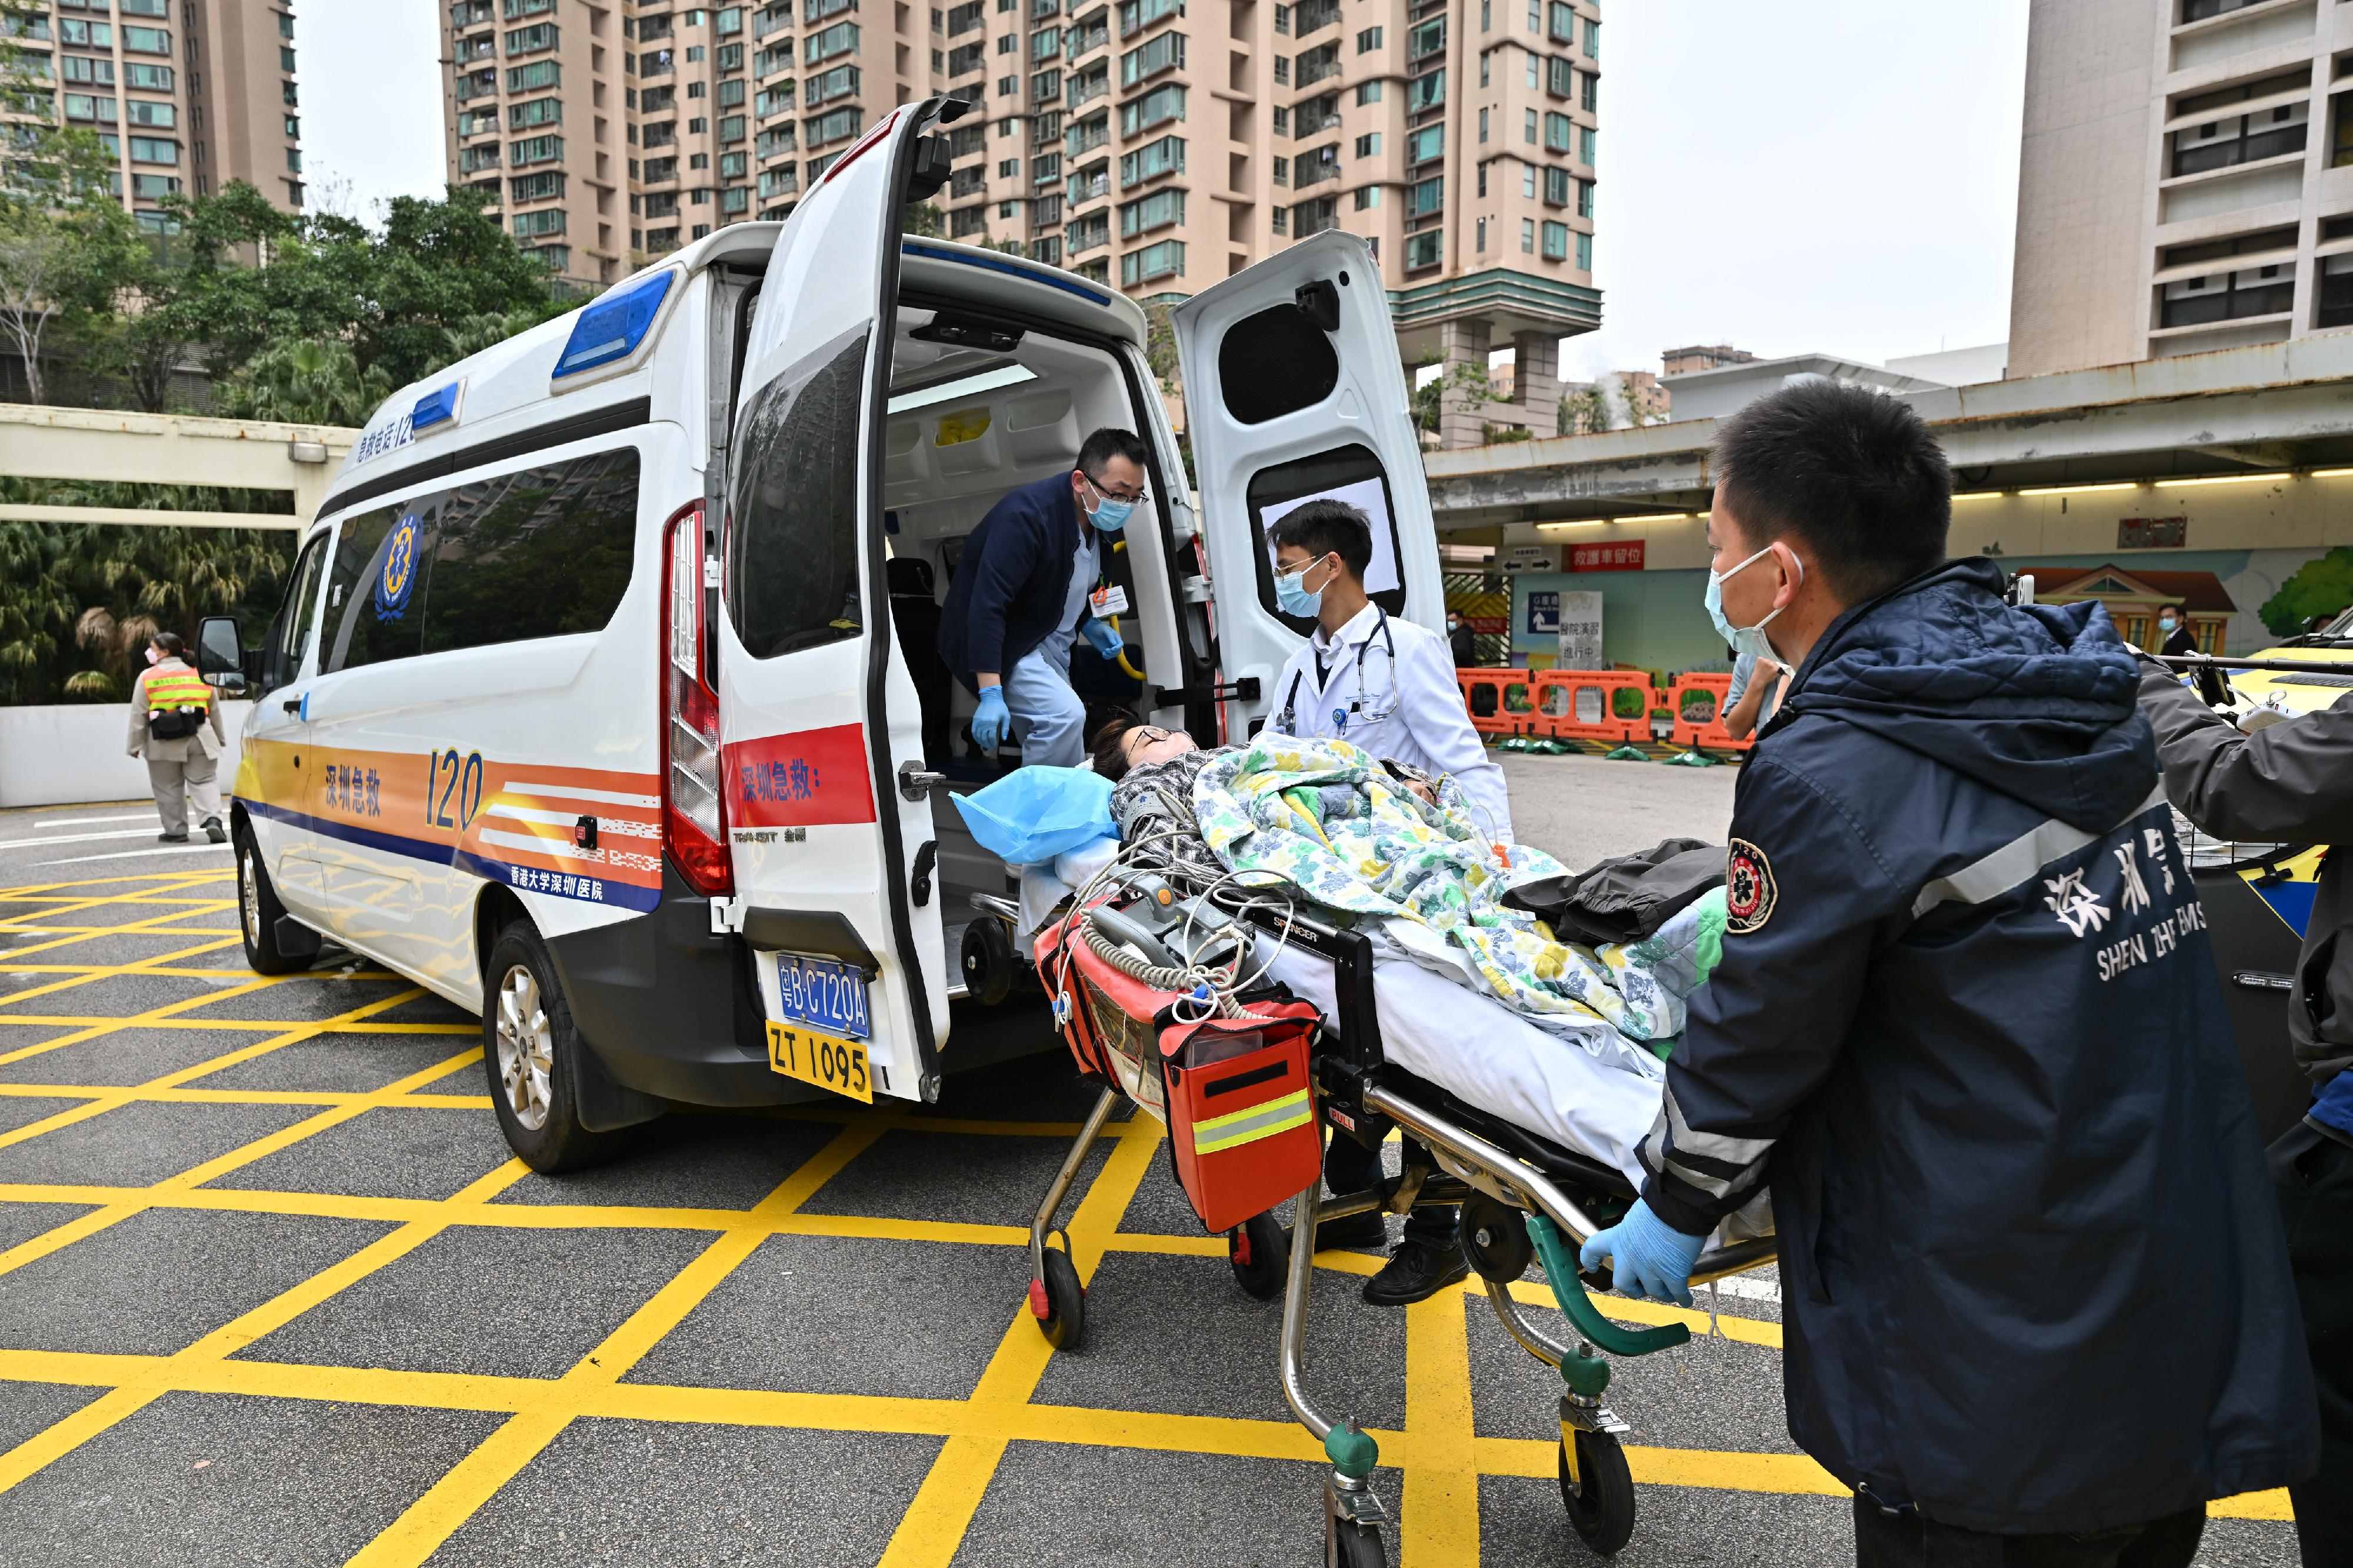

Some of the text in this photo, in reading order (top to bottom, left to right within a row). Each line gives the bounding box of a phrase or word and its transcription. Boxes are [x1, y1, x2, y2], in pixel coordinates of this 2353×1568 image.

[1574, 548, 1641, 566] 救護車留位
[1561, 622, 1599, 636] 醫院演習
[1564, 646, 1593, 659] 進行中
[326, 764, 381, 818] 深圳急救
[425, 746, 484, 832] 120
[733, 831, 778, 843] TRANSIT
[1738, 843, 1758, 860] 120
[511, 866, 603, 901] 香港大学深圳医院
[2097, 934, 2148, 981] SHEN
[2175, 901, 2207, 936] EMS
[771, 1027, 866, 1093] ZT 1095
[1331, 1110, 1353, 1130] PULL
